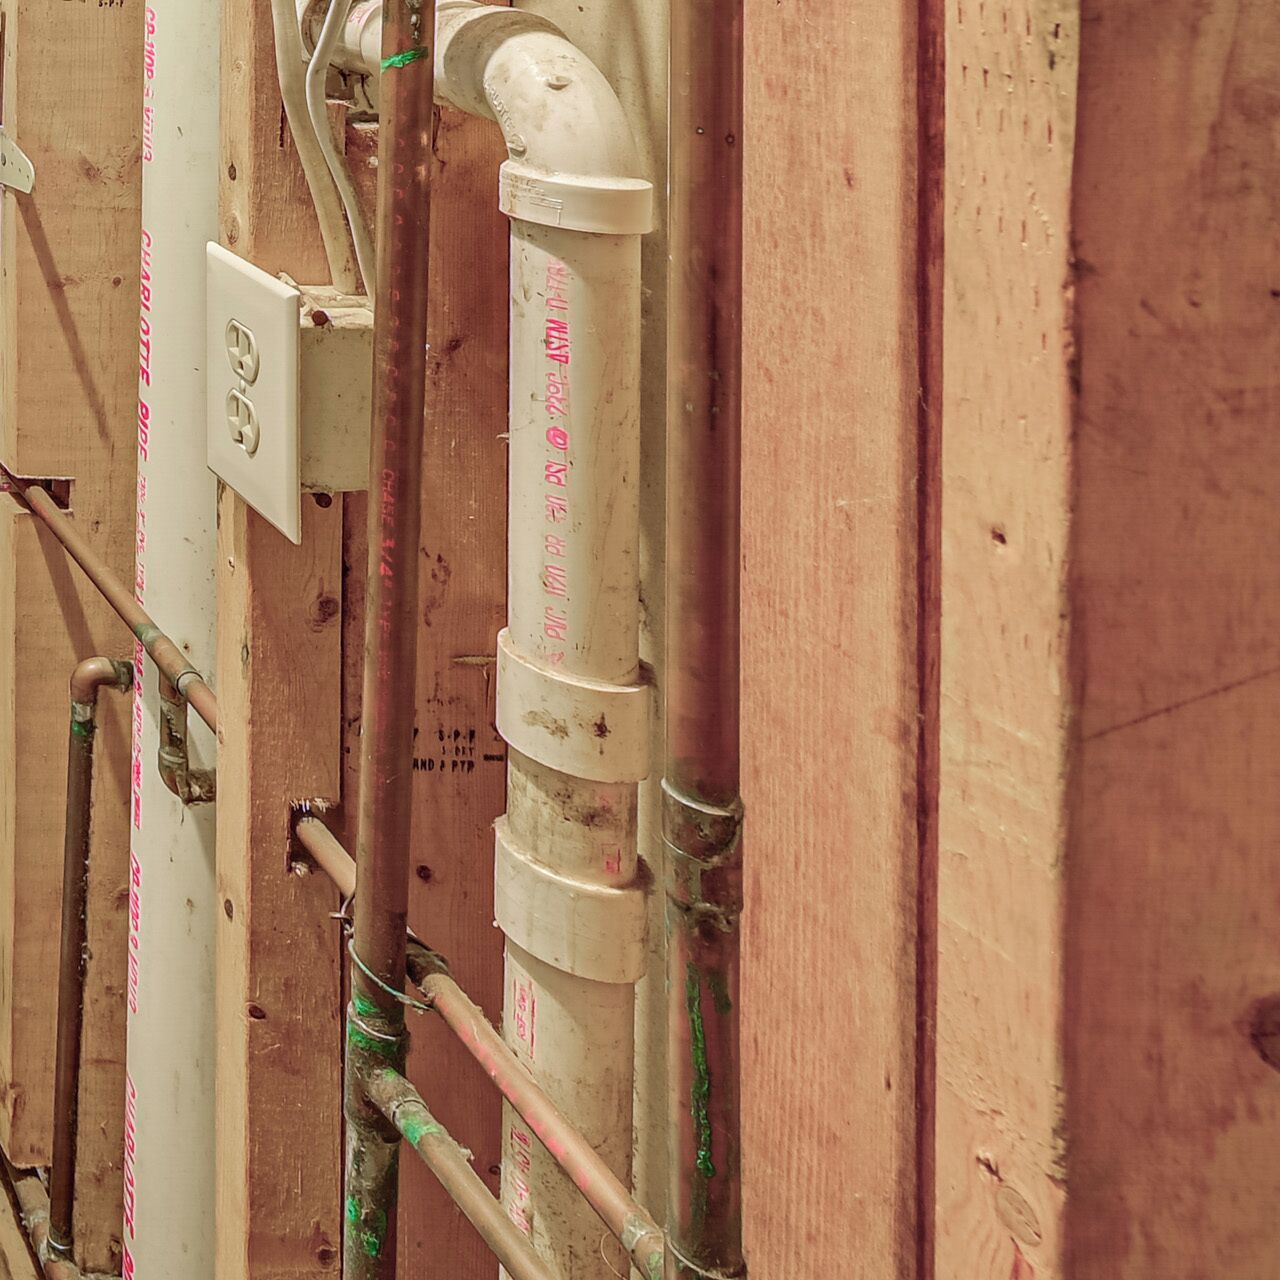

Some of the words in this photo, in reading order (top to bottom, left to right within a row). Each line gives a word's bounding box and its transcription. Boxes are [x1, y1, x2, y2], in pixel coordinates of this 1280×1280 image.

[545, 320, 569, 364] ASTM
[546, 427, 568, 452] @
[546, 460, 568, 486] PSI
[381, 471, 395, 526] CHASE
